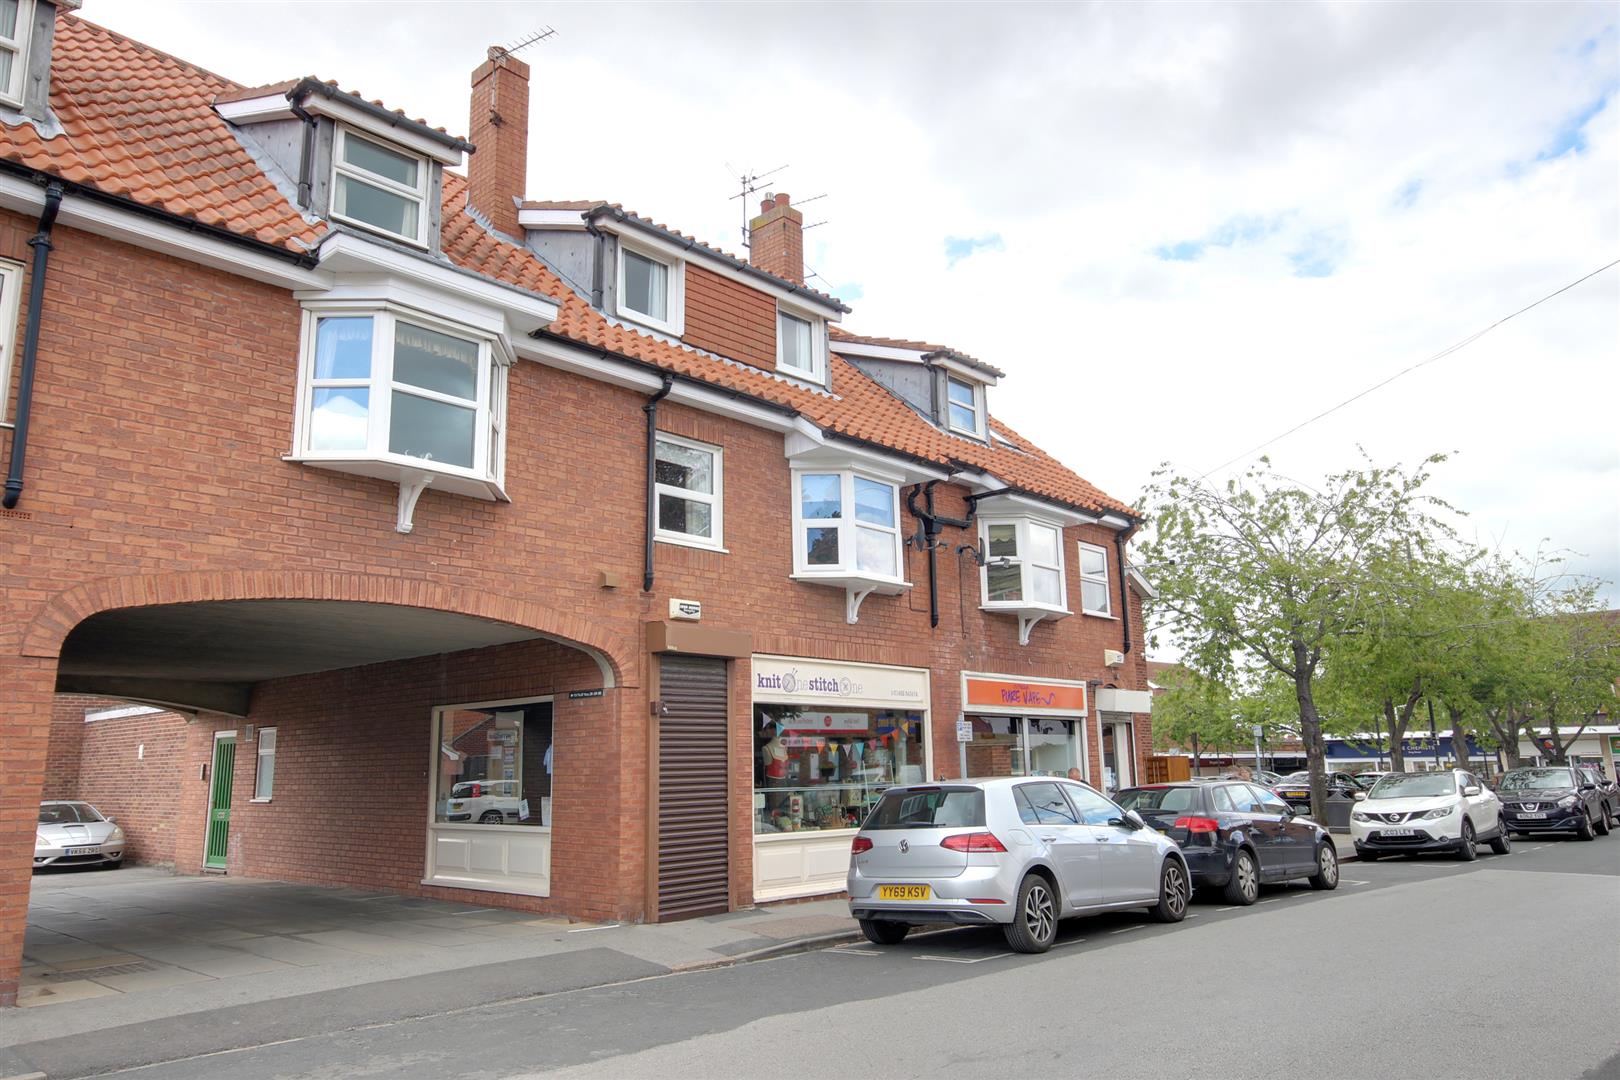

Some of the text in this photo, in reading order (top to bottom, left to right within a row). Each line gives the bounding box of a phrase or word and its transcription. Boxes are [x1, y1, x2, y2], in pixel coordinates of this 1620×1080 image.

[757, 673, 781, 689] knit
[809, 677, 839, 692] stitch
[1001, 688, 1041, 705] PURE VAPE
[882, 886, 926, 898] YY69 KSV
